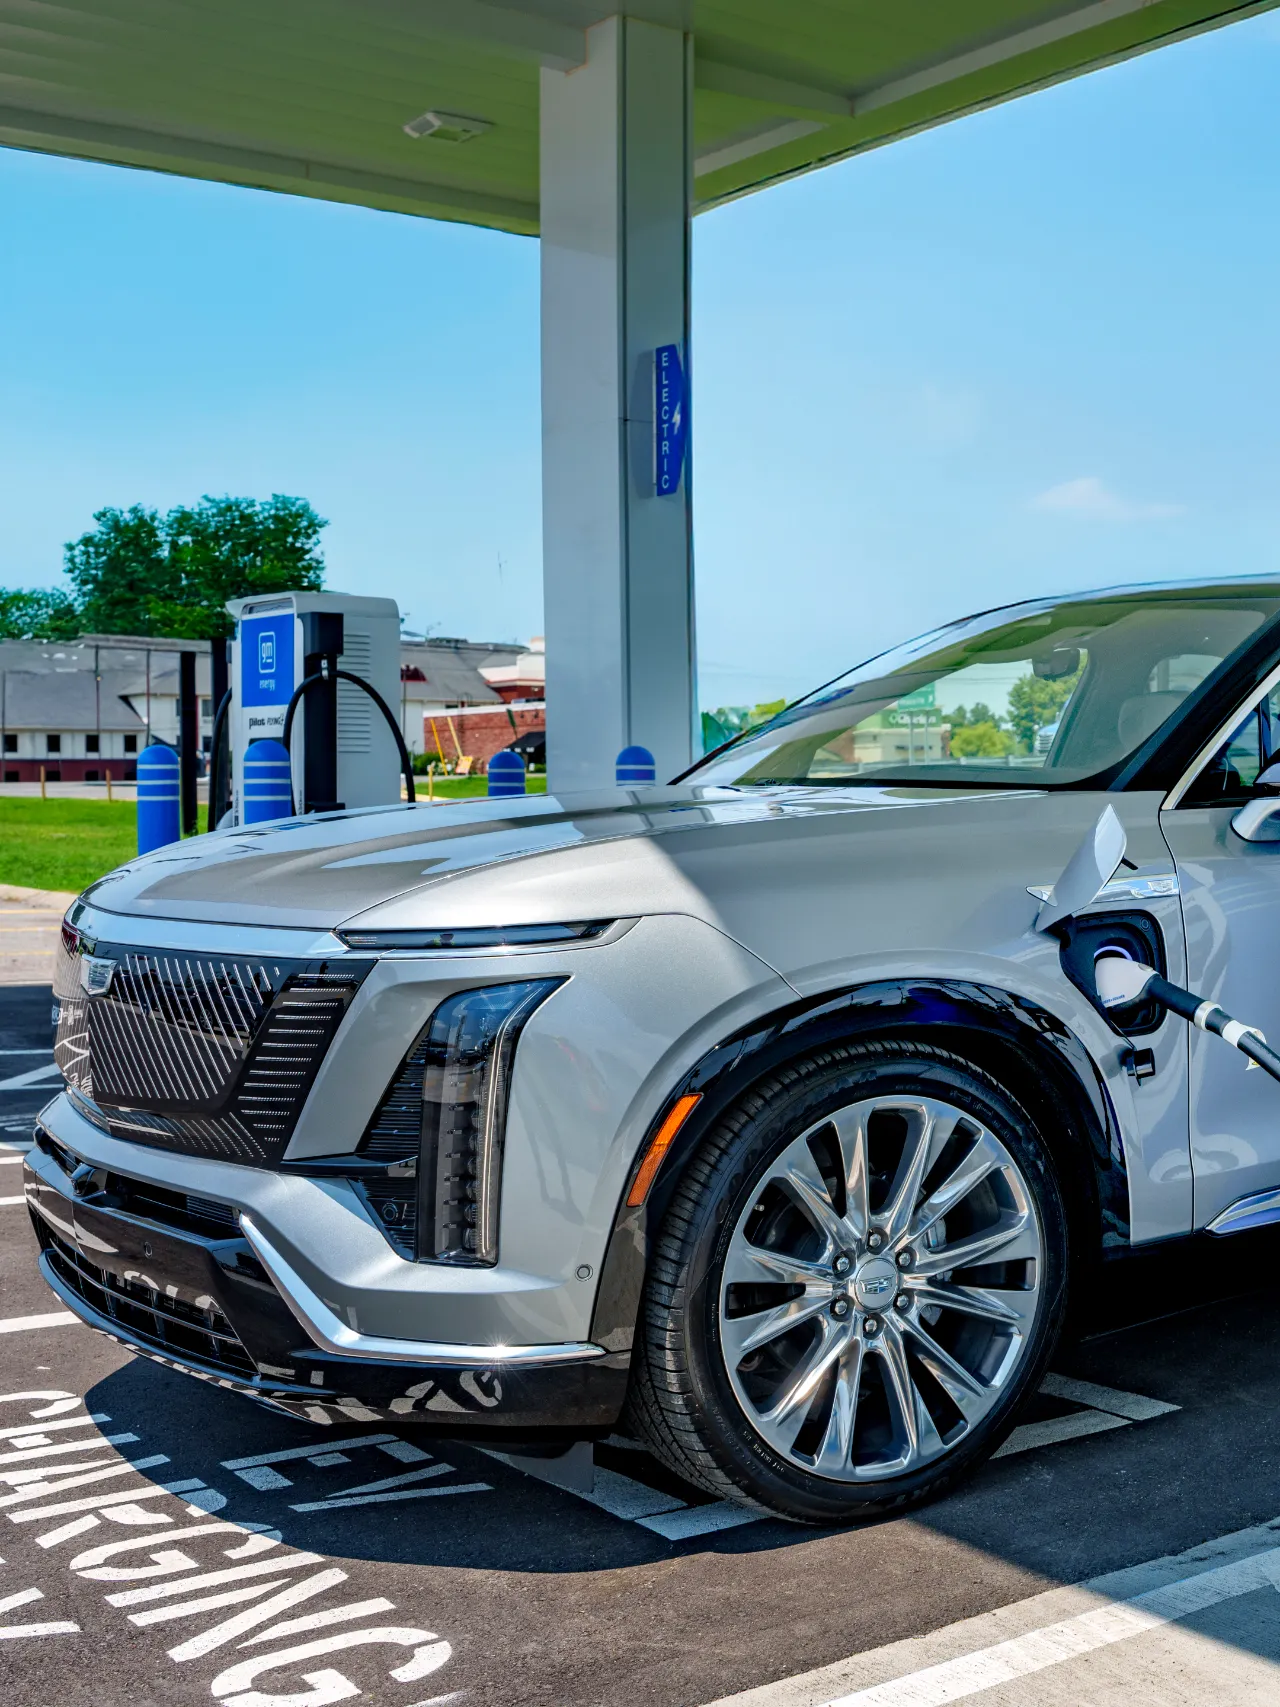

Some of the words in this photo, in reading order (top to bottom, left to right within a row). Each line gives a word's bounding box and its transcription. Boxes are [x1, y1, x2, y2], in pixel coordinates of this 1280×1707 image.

[661, 352, 669, 488] ELECTRIC
[259, 680, 276, 691] energy
[219, 1433, 495, 1512] EV
[0, 1390, 452, 1707] CHARGING
